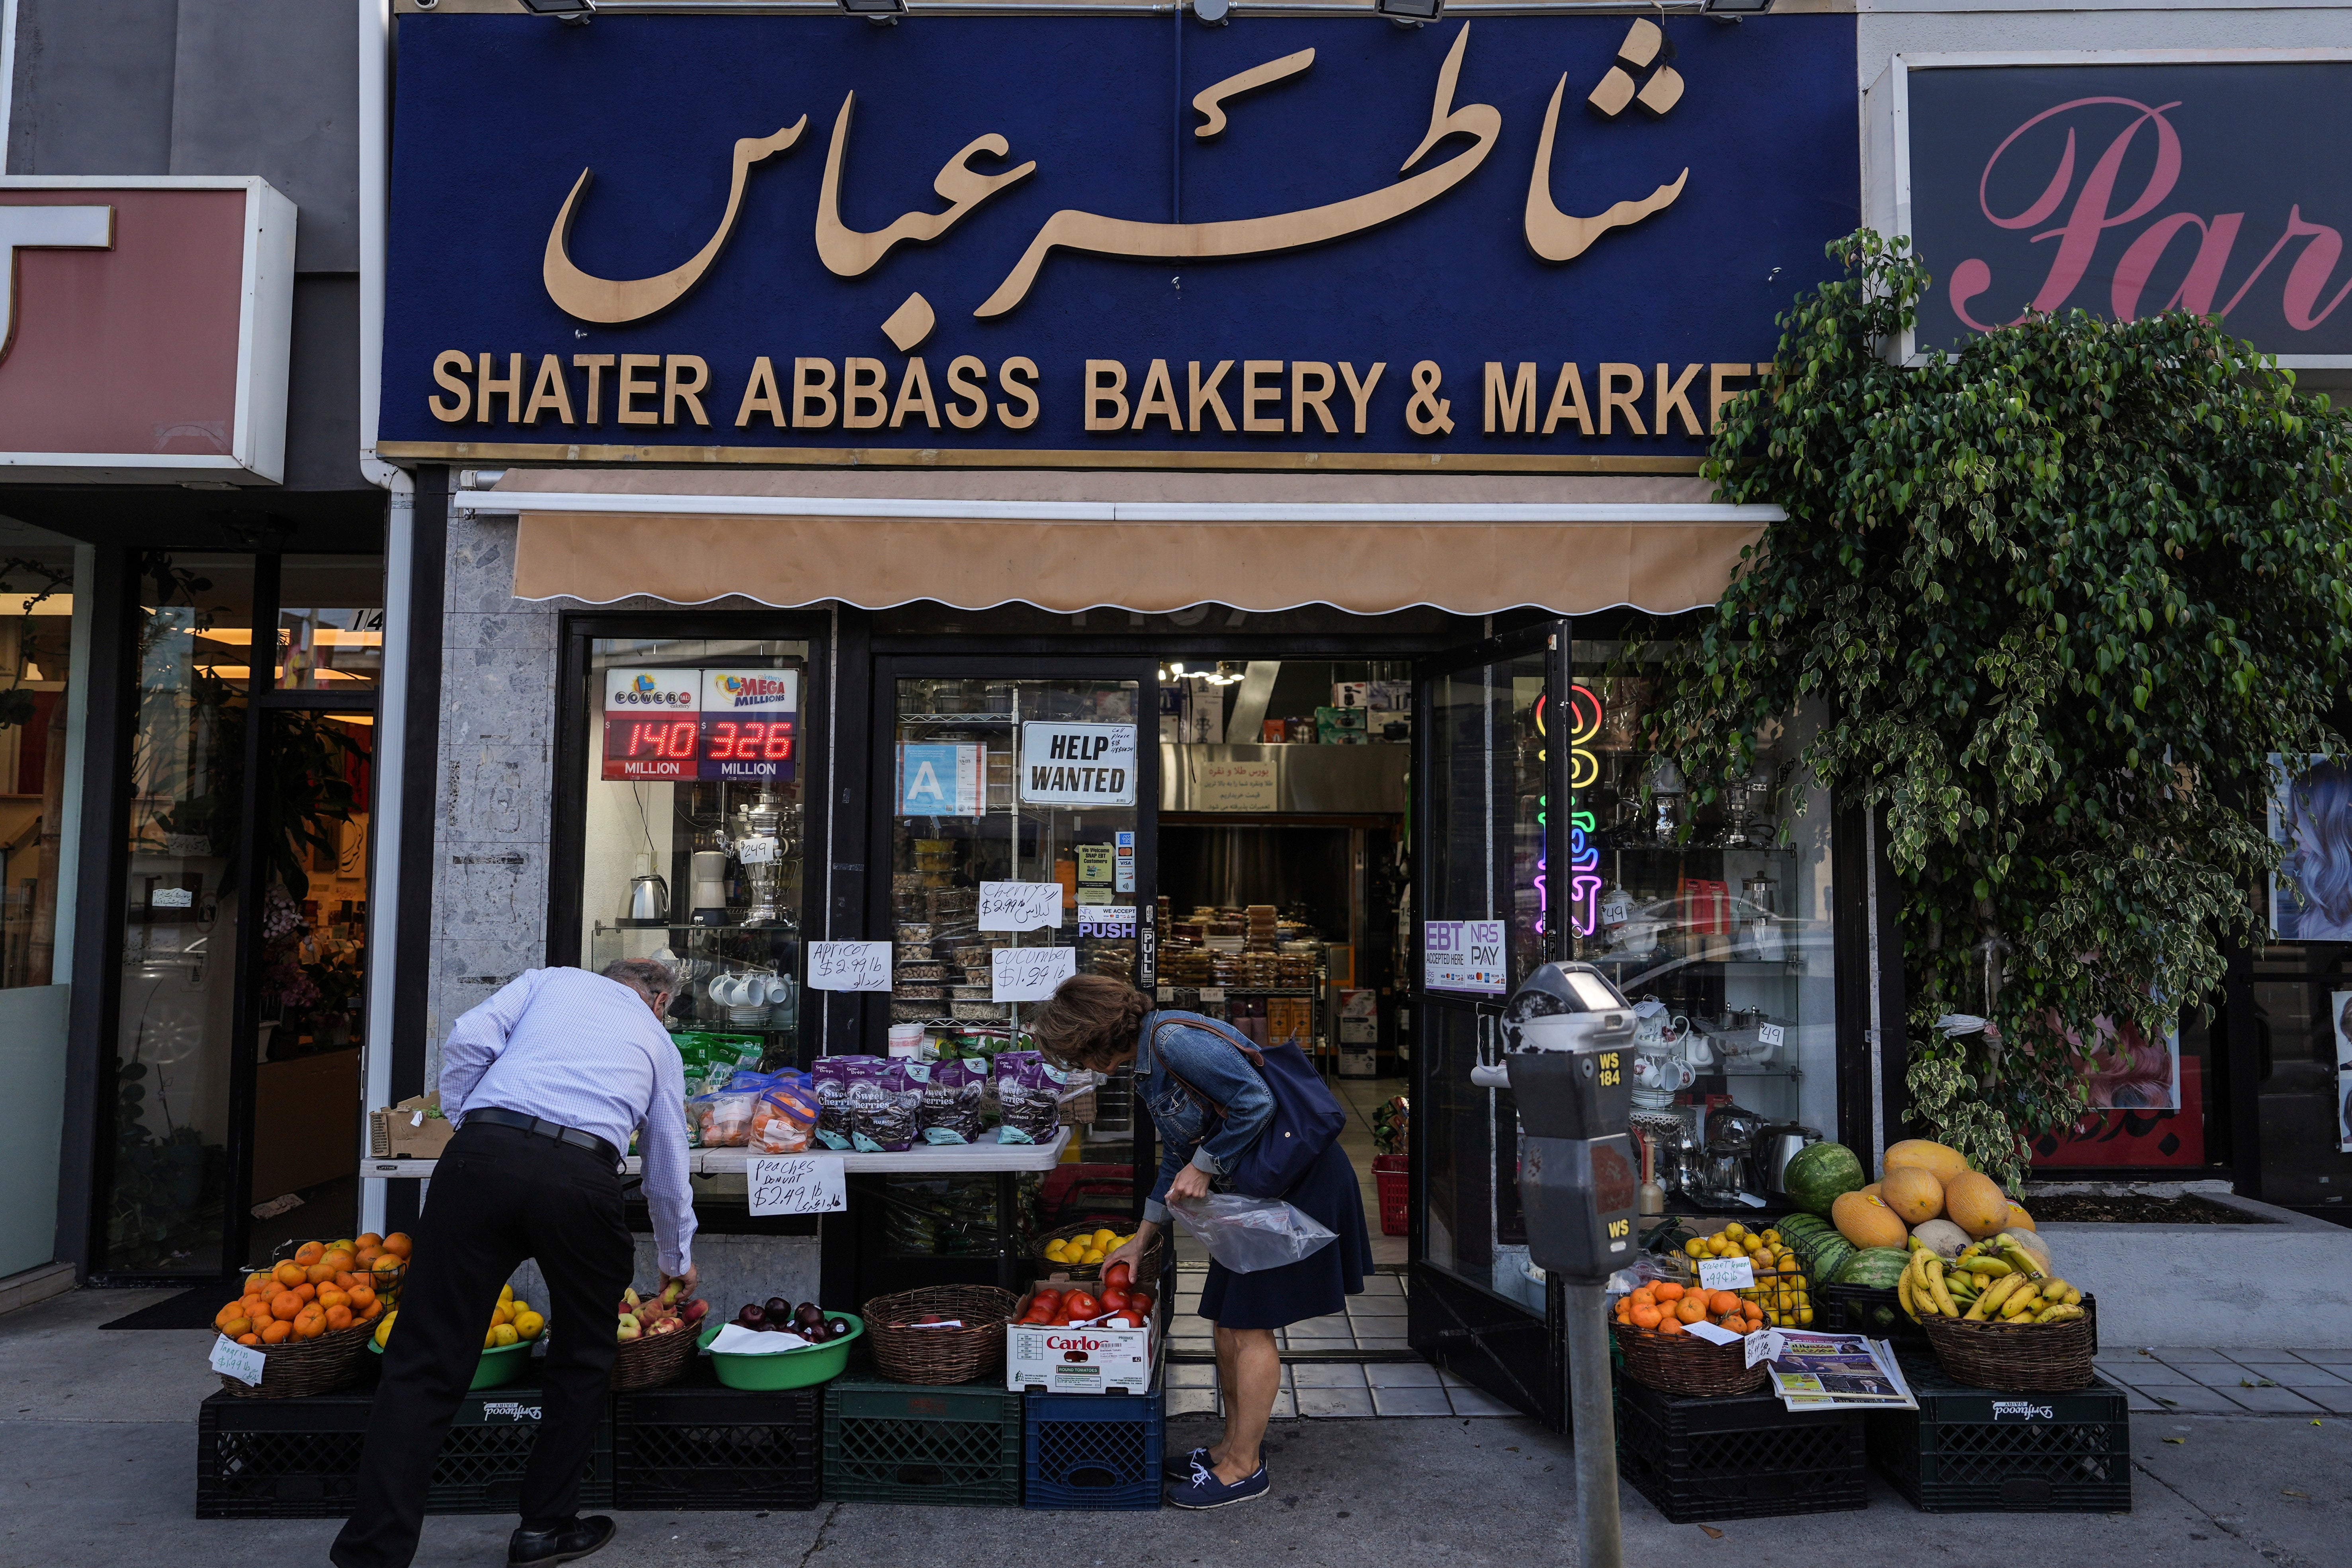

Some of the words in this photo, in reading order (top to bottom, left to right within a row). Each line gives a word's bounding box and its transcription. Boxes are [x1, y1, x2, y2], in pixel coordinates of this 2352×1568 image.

[973, 16, 1688, 320] شاطر
[542, 88, 1037, 352] عباس
[1949, 96, 2352, 332] Par
[429, 350, 712, 428] SHATER
[735, 354, 1039, 432] ABBASS
[1085, 359, 1387, 434] BAKERY
[1405, 359, 1454, 436] &
[736, 677, 785, 697] MEGA
[628, 722, 696, 757] 140
[711, 723, 792, 758] 326
[1050, 735, 1109, 760] HELP
[625, 763, 679, 774] MILLION
[721, 763, 776, 775] MILLION
[906, 761, 944, 800] A
[1032, 766, 1125, 793] WANTED
[740, 840, 766, 858] $249
[982, 898, 1017, 916] $2.99
[1601, 904, 1624, 923] $49
[1079, 923, 1136, 938] PUSH
[1426, 923, 1463, 951] EBT
[1471, 924, 1498, 943] NRS
[1143, 933, 1153, 973] PULL
[1426, 953, 1450, 965] ACCEPTED
[1451, 954, 1464, 965] HERE
[1471, 946, 1499, 966] PAY
[817, 958, 867, 976] $2.99
[869, 957, 881, 971] lb
[1054, 964, 1065, 979] lb
[851, 972, 885, 989] زردالو
[1599, 1052, 1619, 1070] WS
[1599, 1069, 1621, 1086] 184
[819, 1097, 853, 1105] Cherri
[853, 1100, 890, 1109] herries
[856, 1091, 885, 1100] Sweet
[753, 1185, 805, 1208] $2.49
[812, 1181, 822, 1201] lb
[1608, 1218, 1629, 1238] WS
[216, 1355, 242, 1370] $1.99
[243, 1361, 250, 1371] lb
[484, 1404, 542, 1422] Driftwood
[1993, 1404, 2053, 1420] Driftwood
